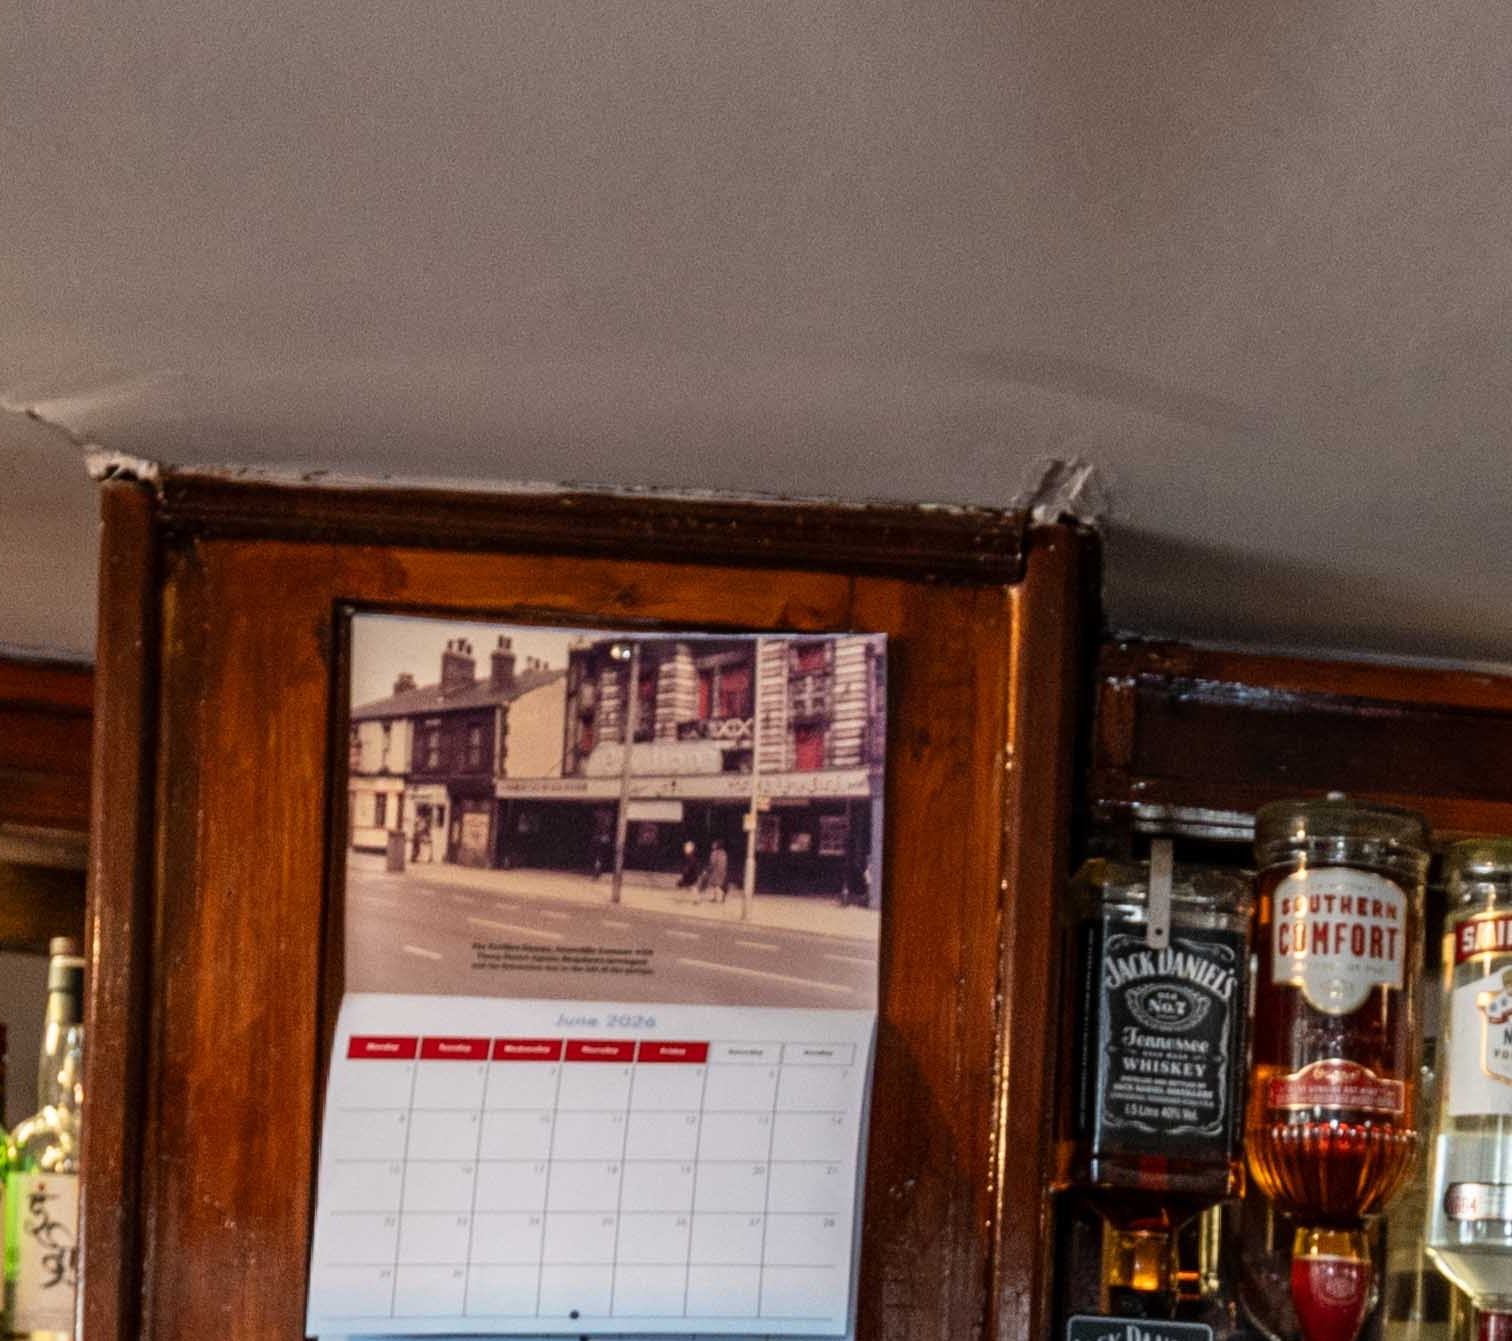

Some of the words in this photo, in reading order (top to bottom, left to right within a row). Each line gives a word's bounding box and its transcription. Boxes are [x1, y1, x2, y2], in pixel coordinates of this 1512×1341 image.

[1282, 895, 1397, 920] SOUTHERN
[1279, 921, 1399, 961] COMFORT
[1106, 952, 1155, 989] JACK
[1158, 946, 1237, 999] DANIEL'S
[1122, 1026, 1209, 1053] Tennessee
[1122, 1057, 1207, 1078] WHISKEY
